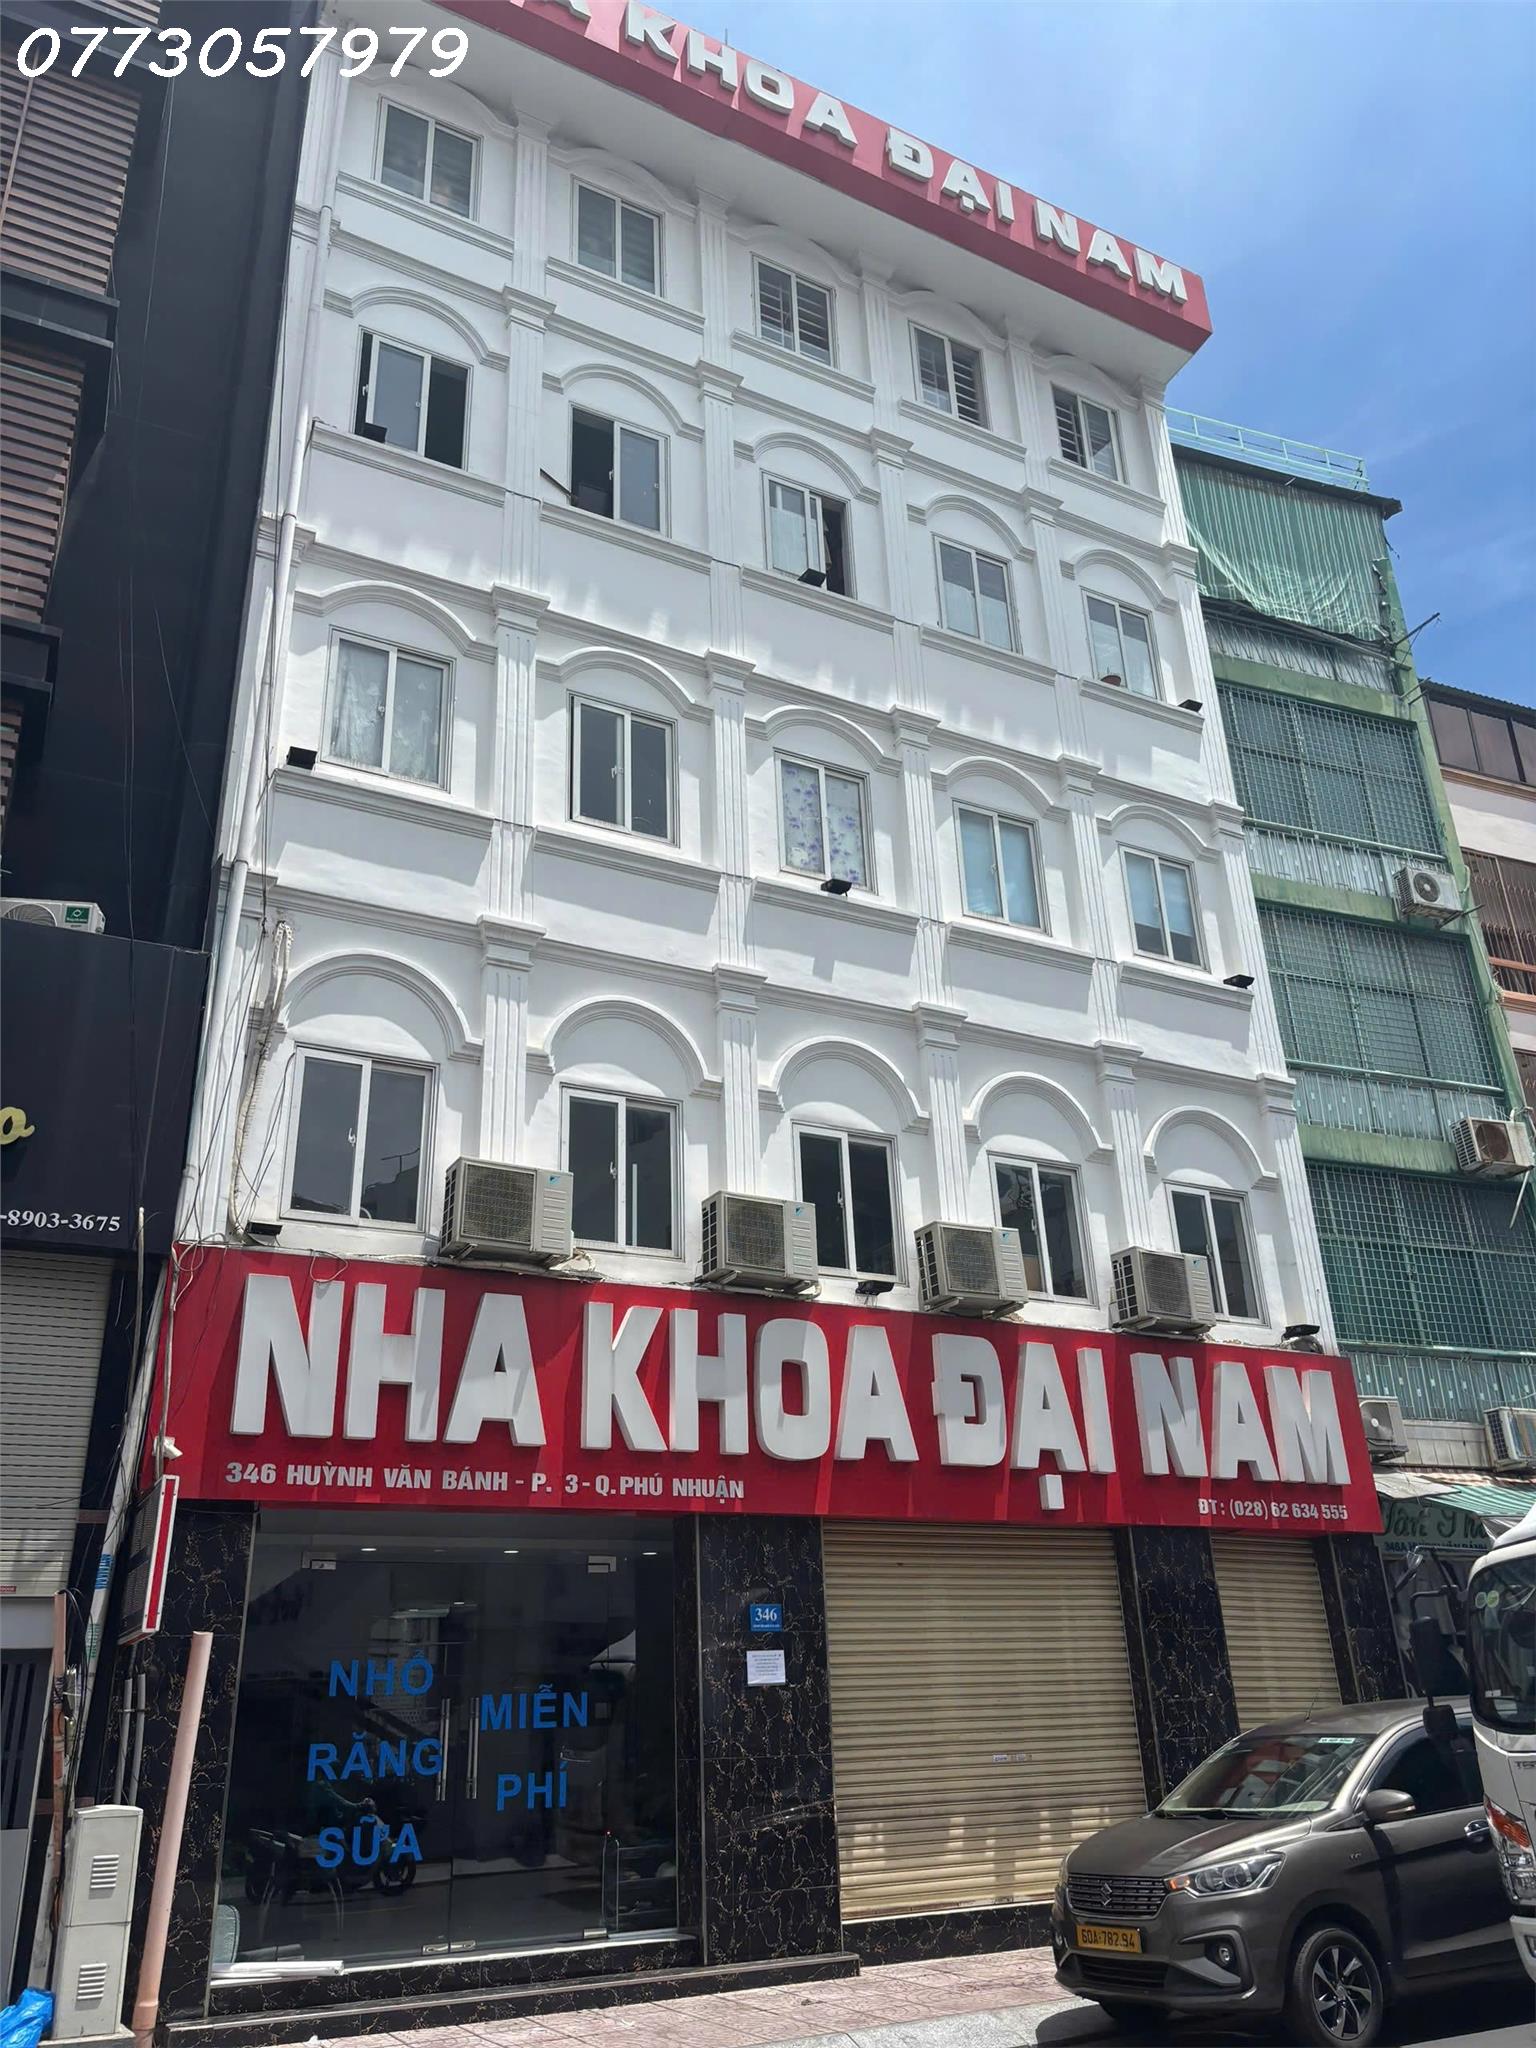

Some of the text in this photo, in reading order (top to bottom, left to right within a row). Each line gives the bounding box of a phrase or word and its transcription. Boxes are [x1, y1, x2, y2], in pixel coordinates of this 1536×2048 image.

[626, 0, 1187, 305] KHOA ĐẠI NAM
[231, 1272, 1351, 1511] NHA KHOA ĐẠI NAM
[224, 1461, 277, 1484] 346
[286, 1460, 373, 1488] HUỲNH
[383, 1463, 431, 1489] VĂN
[442, 1466, 508, 1491] BÁNH
[672, 1475, 745, 1504] NHUẬN
[1270, 1502, 1289, 1518] 62
[1292, 1503, 1319, 1519] 634
[1321, 1504, 1348, 1520] 555
[755, 1607, 778, 1622] 346
[480, 1683, 588, 1731] MIỄN
[306, 1731, 442, 1782] RĂNG
[496, 1761, 569, 1811] PHÍ
[315, 1814, 423, 1868] SỮA
